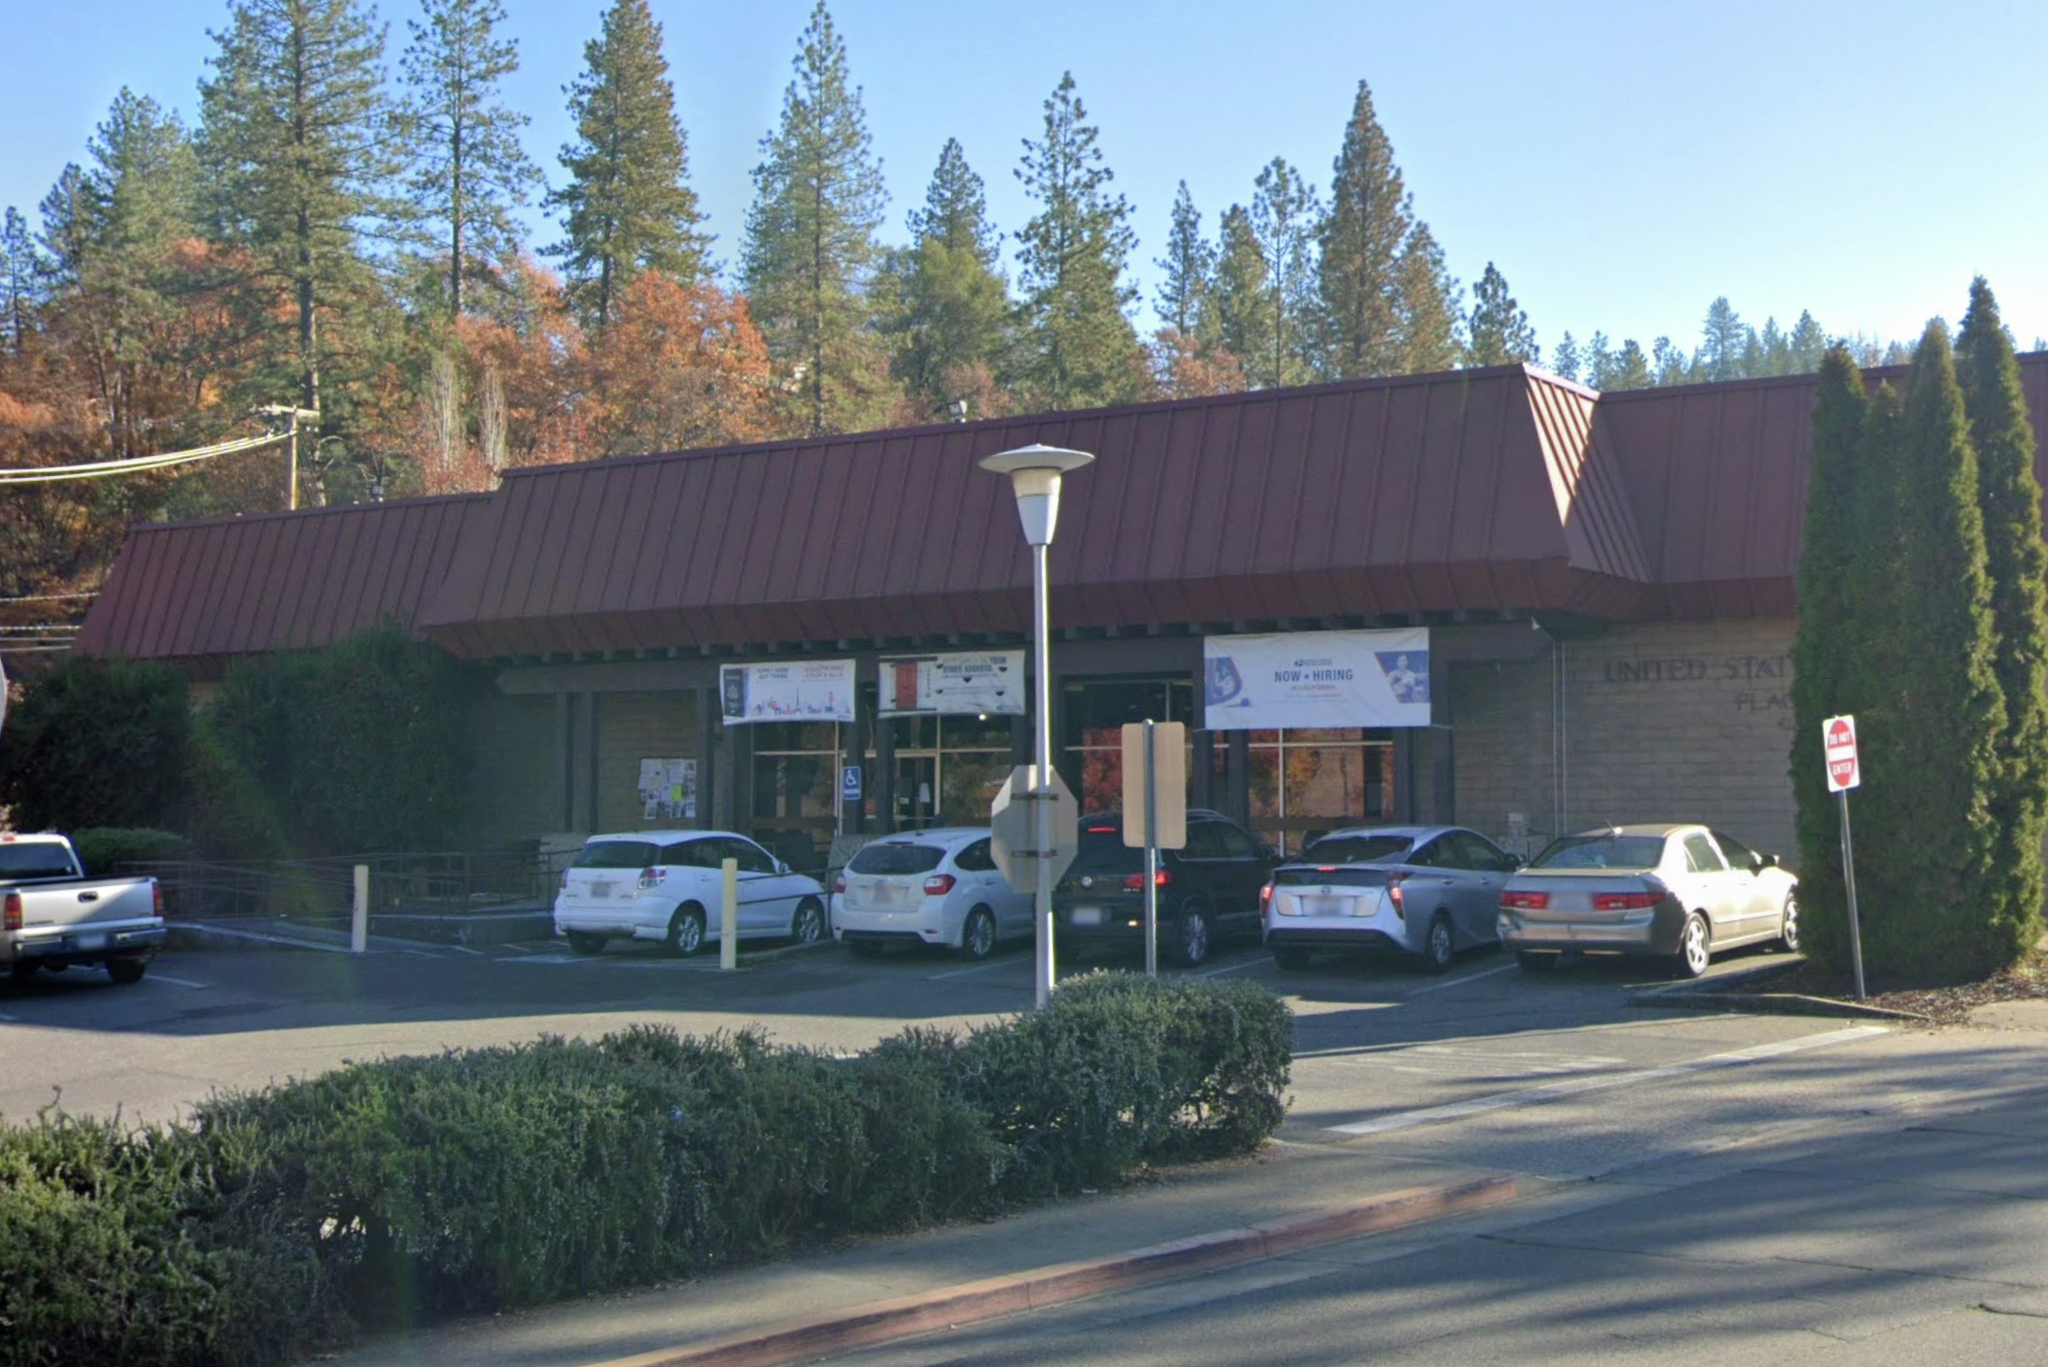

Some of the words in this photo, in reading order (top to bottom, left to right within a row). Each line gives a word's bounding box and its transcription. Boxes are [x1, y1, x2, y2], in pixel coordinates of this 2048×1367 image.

[1274, 671, 1301, 682] NOW
[1313, 668, 1354, 681] HIRING
[1604, 658, 1706, 682] UNITED
[1829, 733, 1838, 745] DO
[1838, 730, 1851, 743] NOT
[1832, 761, 1852, 775] ENTER
